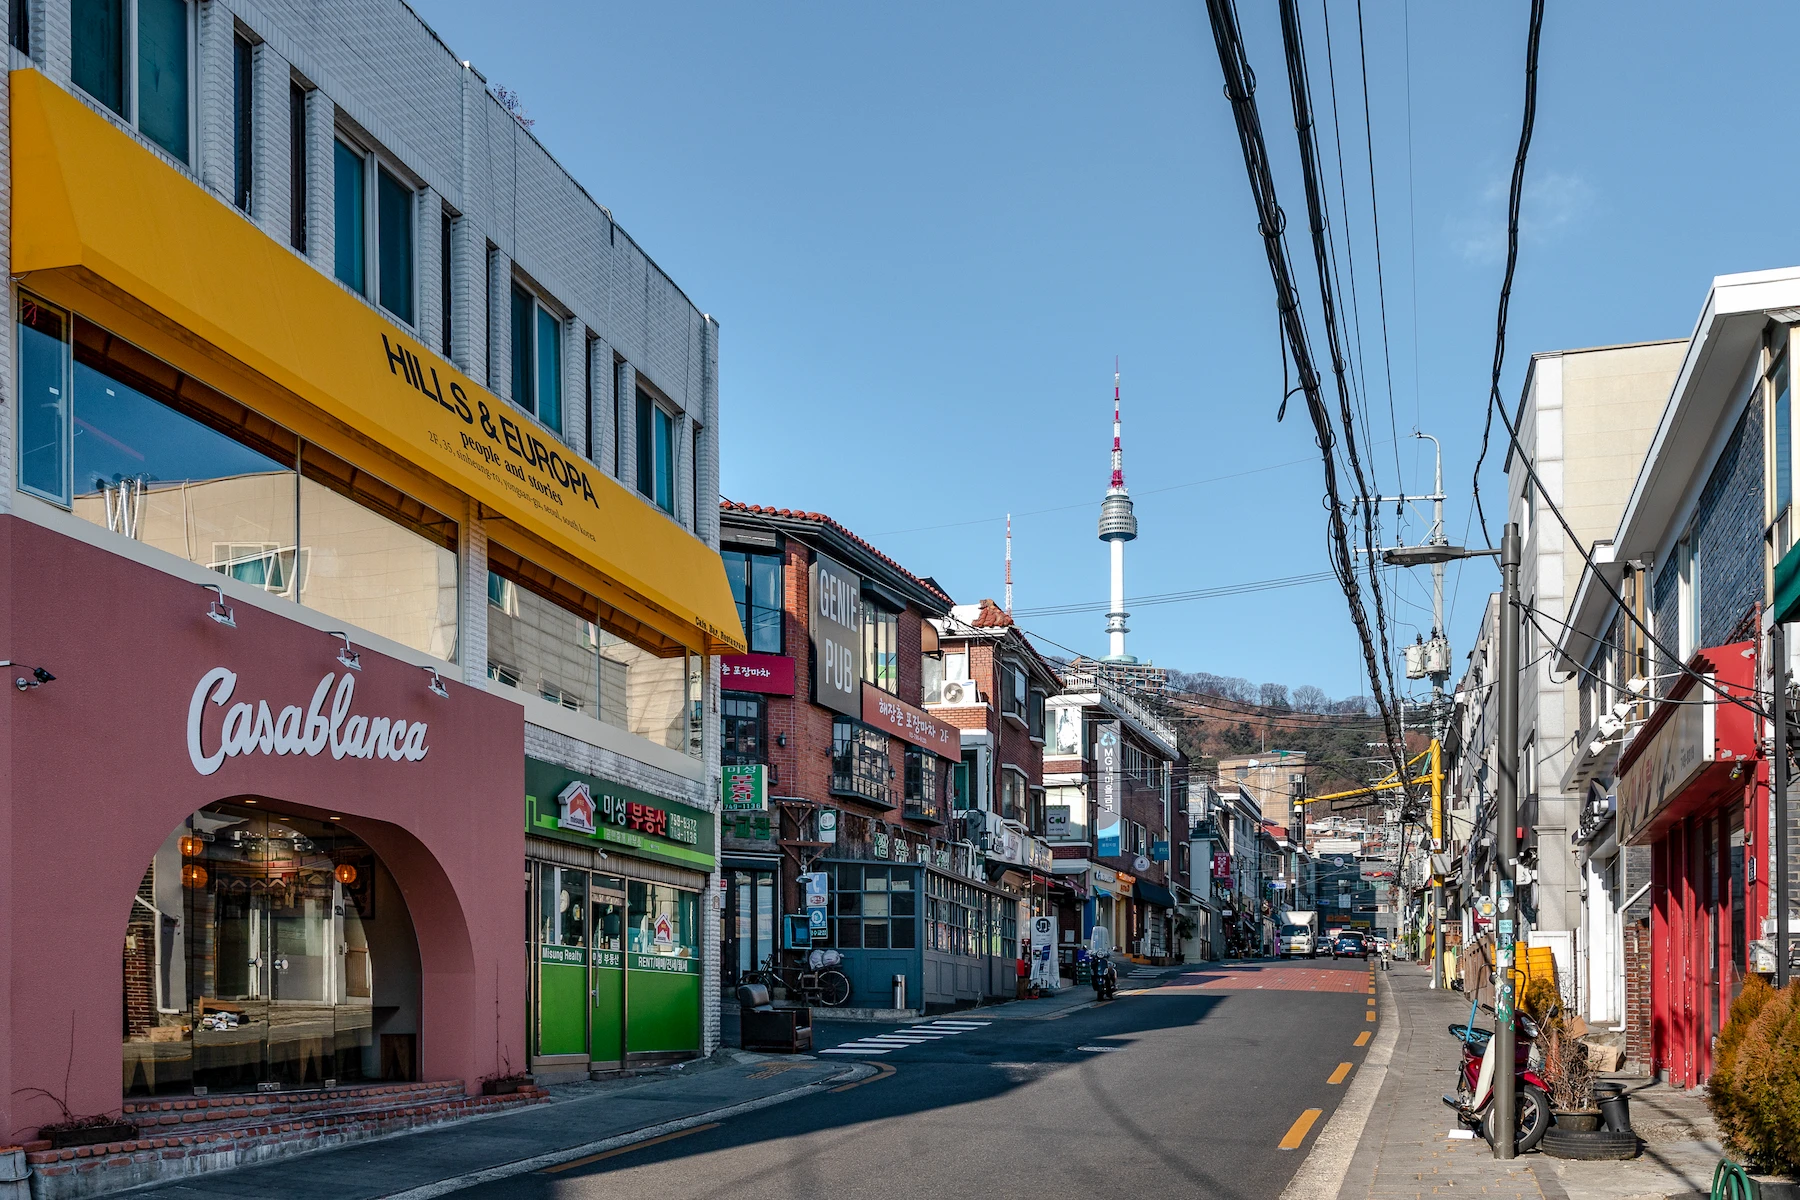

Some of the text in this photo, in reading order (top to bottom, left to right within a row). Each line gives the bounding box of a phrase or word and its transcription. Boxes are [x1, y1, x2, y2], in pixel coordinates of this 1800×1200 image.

[381, 332, 600, 509] HILLS & EUROPA
[459, 431, 563, 506] people and stories
[820, 568, 857, 632] GENIE
[733, 665, 771, 677] 포장마차
[825, 638, 853, 694] PUB
[186, 666, 430, 776] Casablanca
[905, 712, 936, 738] 포장마차
[939, 728, 949, 743] 2F
[727, 766, 757, 774] 미성
[728, 774, 756, 803] 부동산
[1104, 748, 1114, 813] MG새마을금고
[603, 794, 667, 837] 미성 부동산
[542, 947, 583, 963] Misung Realty
[603, 953, 620, 966] 부동산
